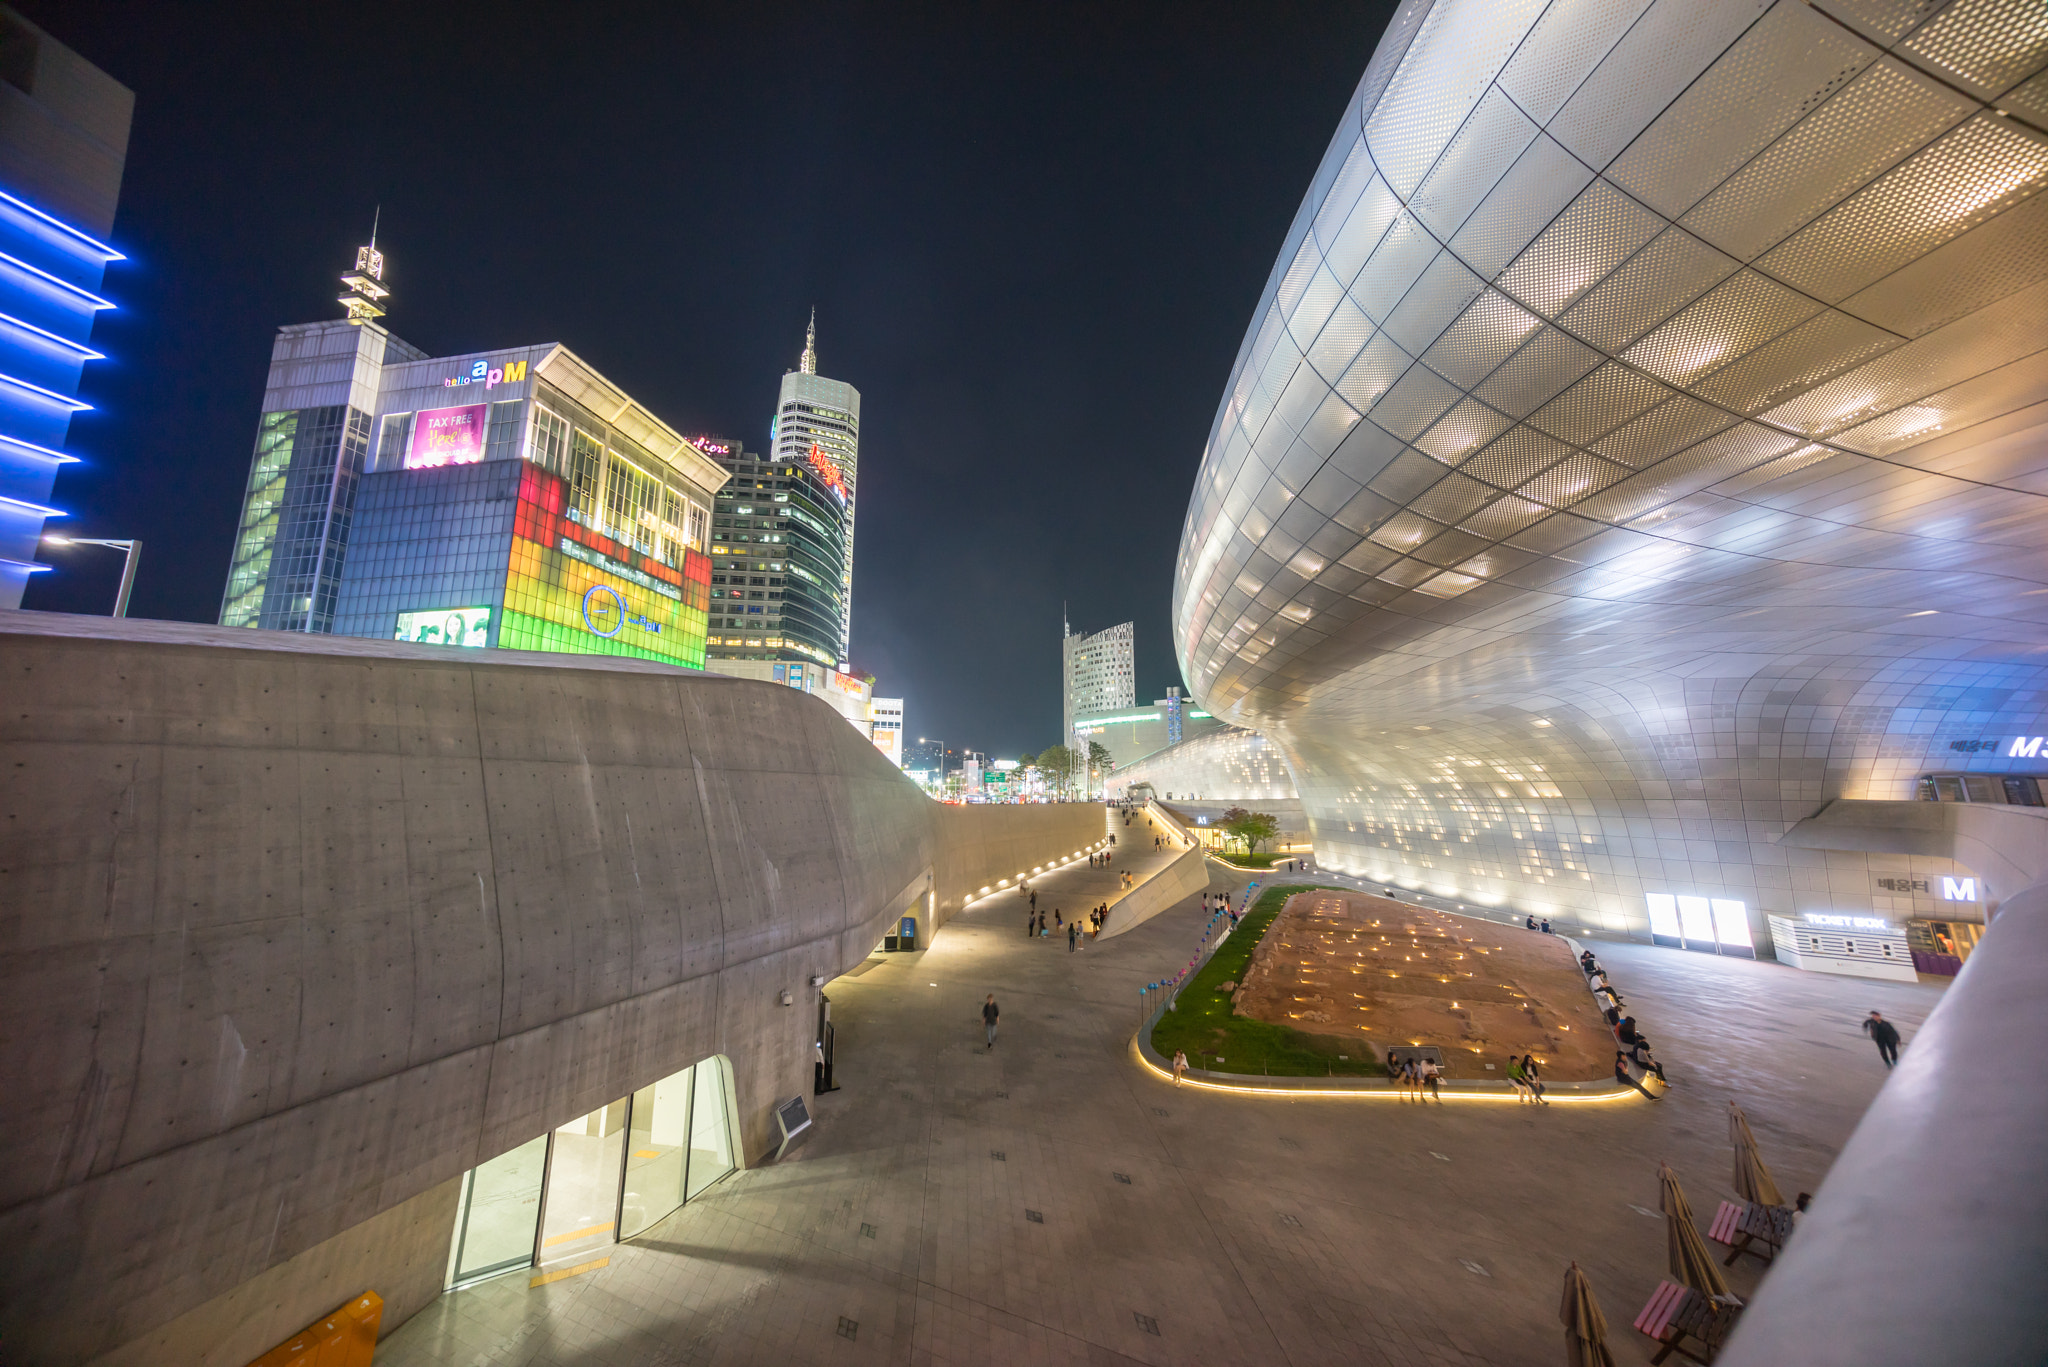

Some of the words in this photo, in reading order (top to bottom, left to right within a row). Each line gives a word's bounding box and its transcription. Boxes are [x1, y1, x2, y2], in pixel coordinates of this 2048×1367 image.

[444, 376, 471, 388] hello
[471, 360, 528, 390] apM
[428, 417, 449, 428] TAX
[450, 414, 473, 425] FREE
[1878, 878, 1929, 893] 배움터
[1943, 877, 1976, 901] M
[1804, 913, 1853, 927] TICKET
[1852, 916, 1887, 929] BOX
